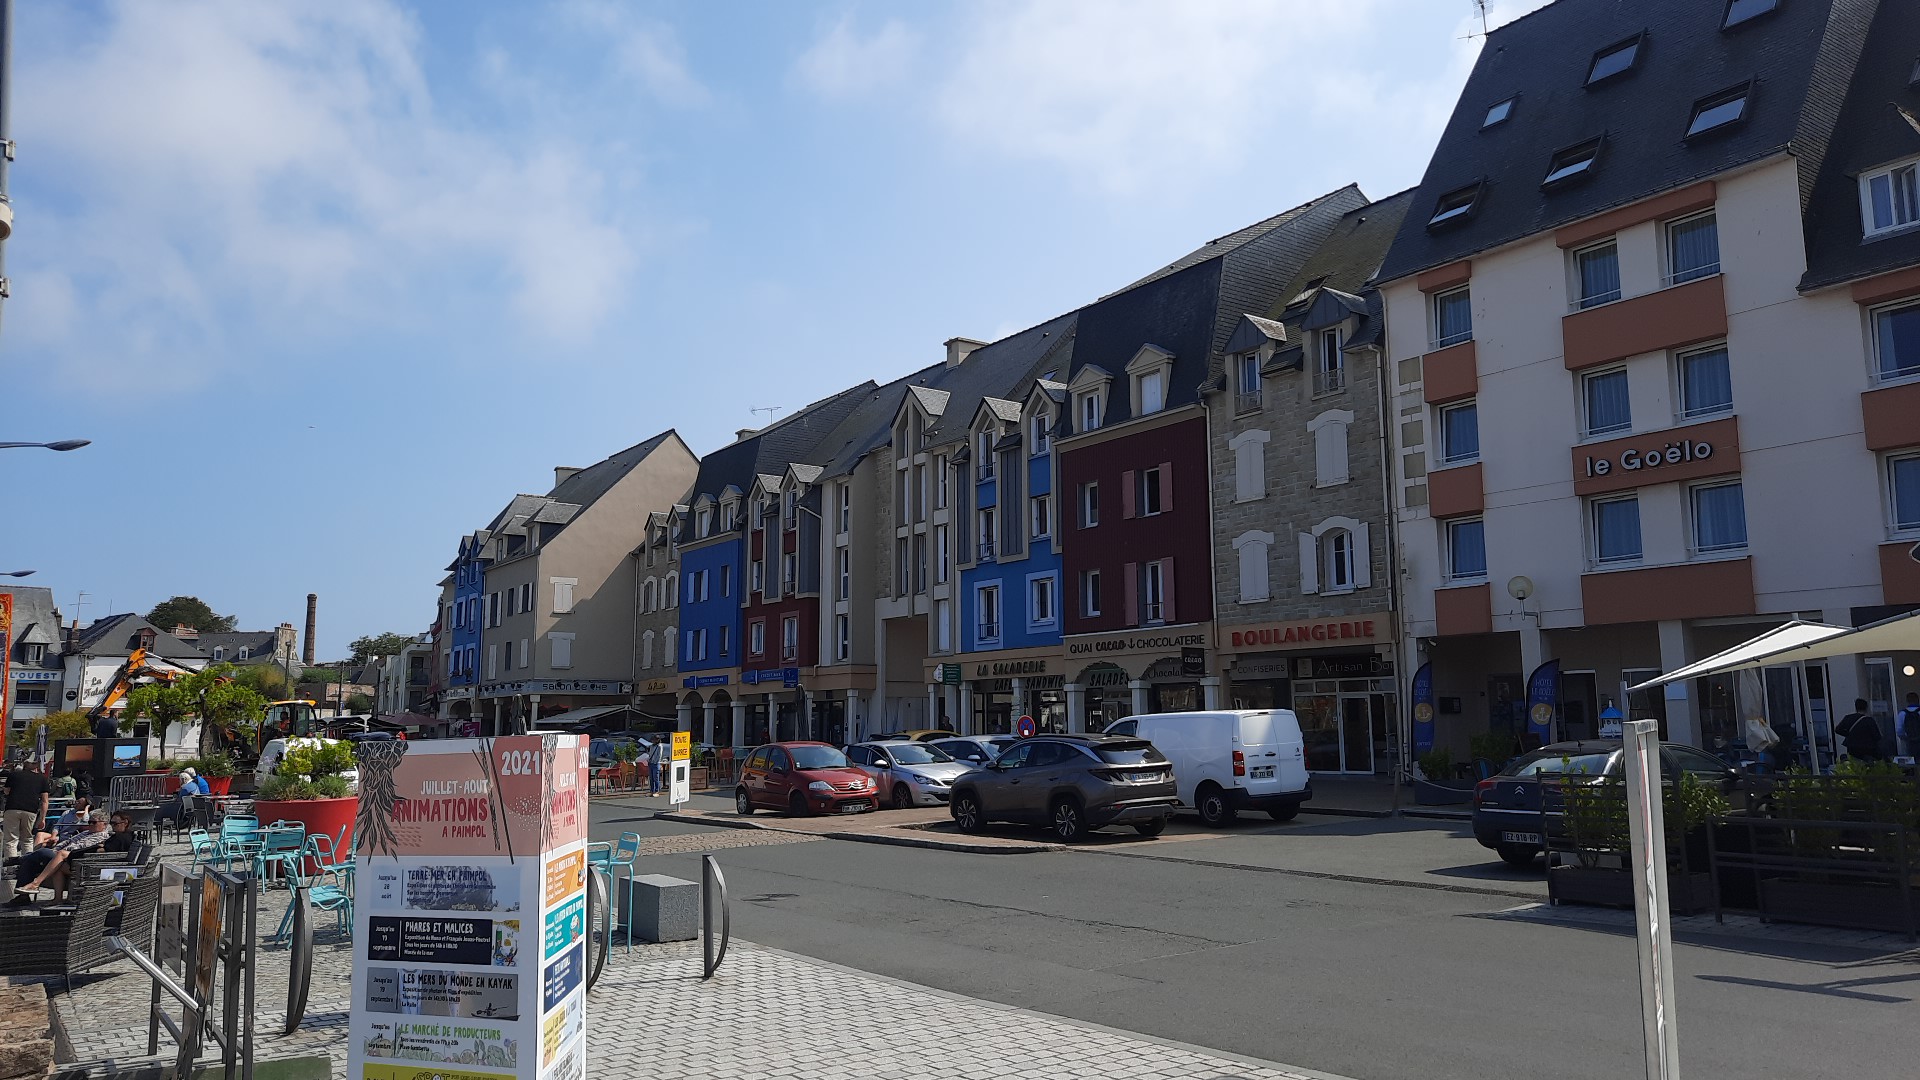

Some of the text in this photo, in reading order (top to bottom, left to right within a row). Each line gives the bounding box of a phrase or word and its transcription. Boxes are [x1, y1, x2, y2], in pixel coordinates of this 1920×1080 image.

[1586, 440, 1714, 477] le Goëlo
[1231, 620, 1375, 647] BOULANGERIE
[1070, 634, 1206, 654] QUAI cacao CHOCOLATERIE
[976, 664, 989, 677] LA
[993, 660, 1047, 676] SALADERIE
[1237, 664, 1286, 674] CONFISERIES
[1317, 660, 1364, 675] Artisan
[10, 672, 57, 680] L'OUEST
[91, 677, 102, 686] La
[1089, 672, 1129, 687] SALADES
[501, 750, 540, 776] 2021
[391, 797, 488, 823] ANIMATIONS
[442, 825, 486, 838] A PAIMPOL
[447, 870, 456, 881] EN
[459, 870, 487, 881] PAIMPOL
[405, 921, 473, 934] PHARES ET MALICES
[403, 974, 513, 989] LES MERS DU MONDE EN KAYAK
[400, 1022, 501, 1040] LE MARCHÉ DE PRODUCTEURS
